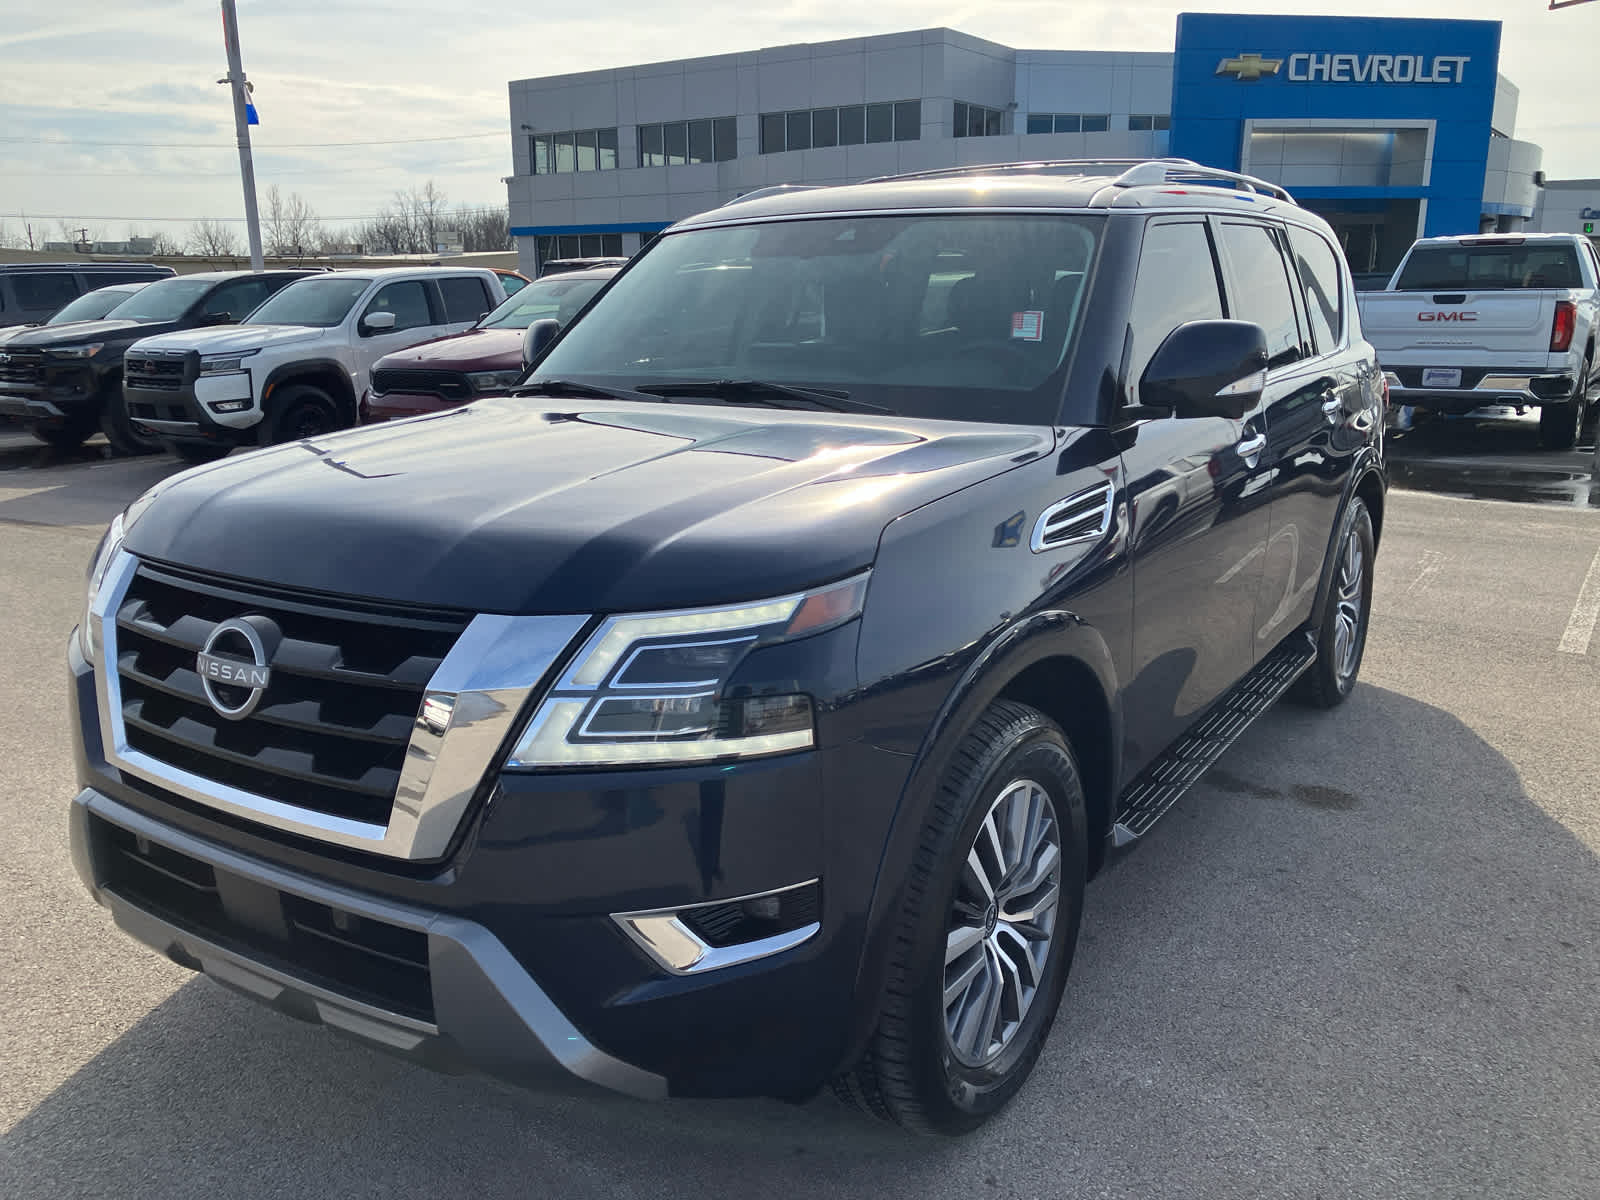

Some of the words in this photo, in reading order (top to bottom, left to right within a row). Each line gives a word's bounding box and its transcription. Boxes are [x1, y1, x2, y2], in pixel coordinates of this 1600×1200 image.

[1289, 53, 1471, 83] CHEVROLET
[1417, 311, 1480, 321] GMC
[198, 657, 266, 685] NISSAN
